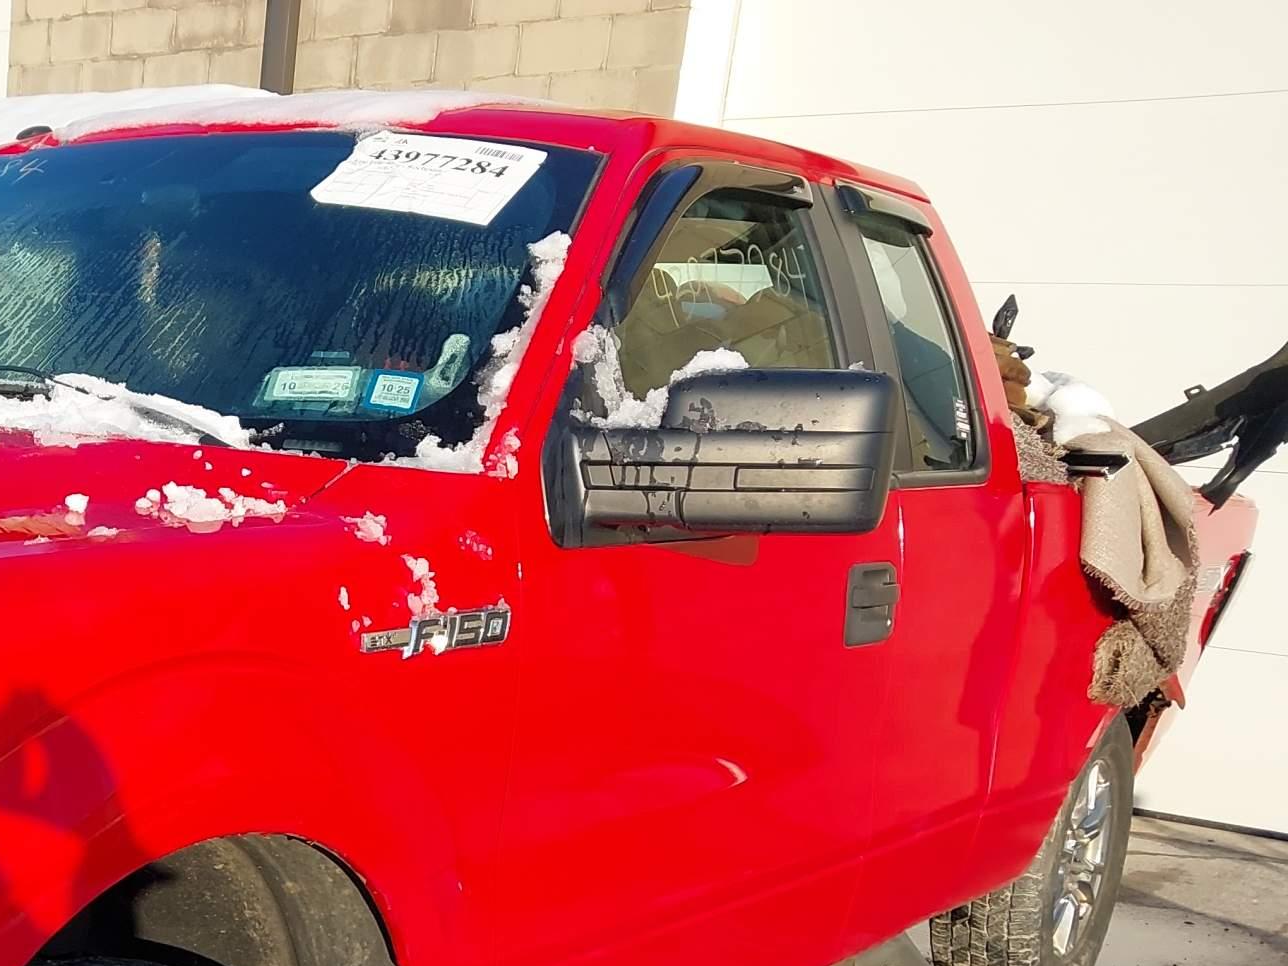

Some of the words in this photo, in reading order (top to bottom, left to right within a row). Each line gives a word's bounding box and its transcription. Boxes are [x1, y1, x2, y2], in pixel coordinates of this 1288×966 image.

[369, 148, 510, 179] 43977284
[381, 384, 394, 393] 10
[396, 385, 410, 395] 25
